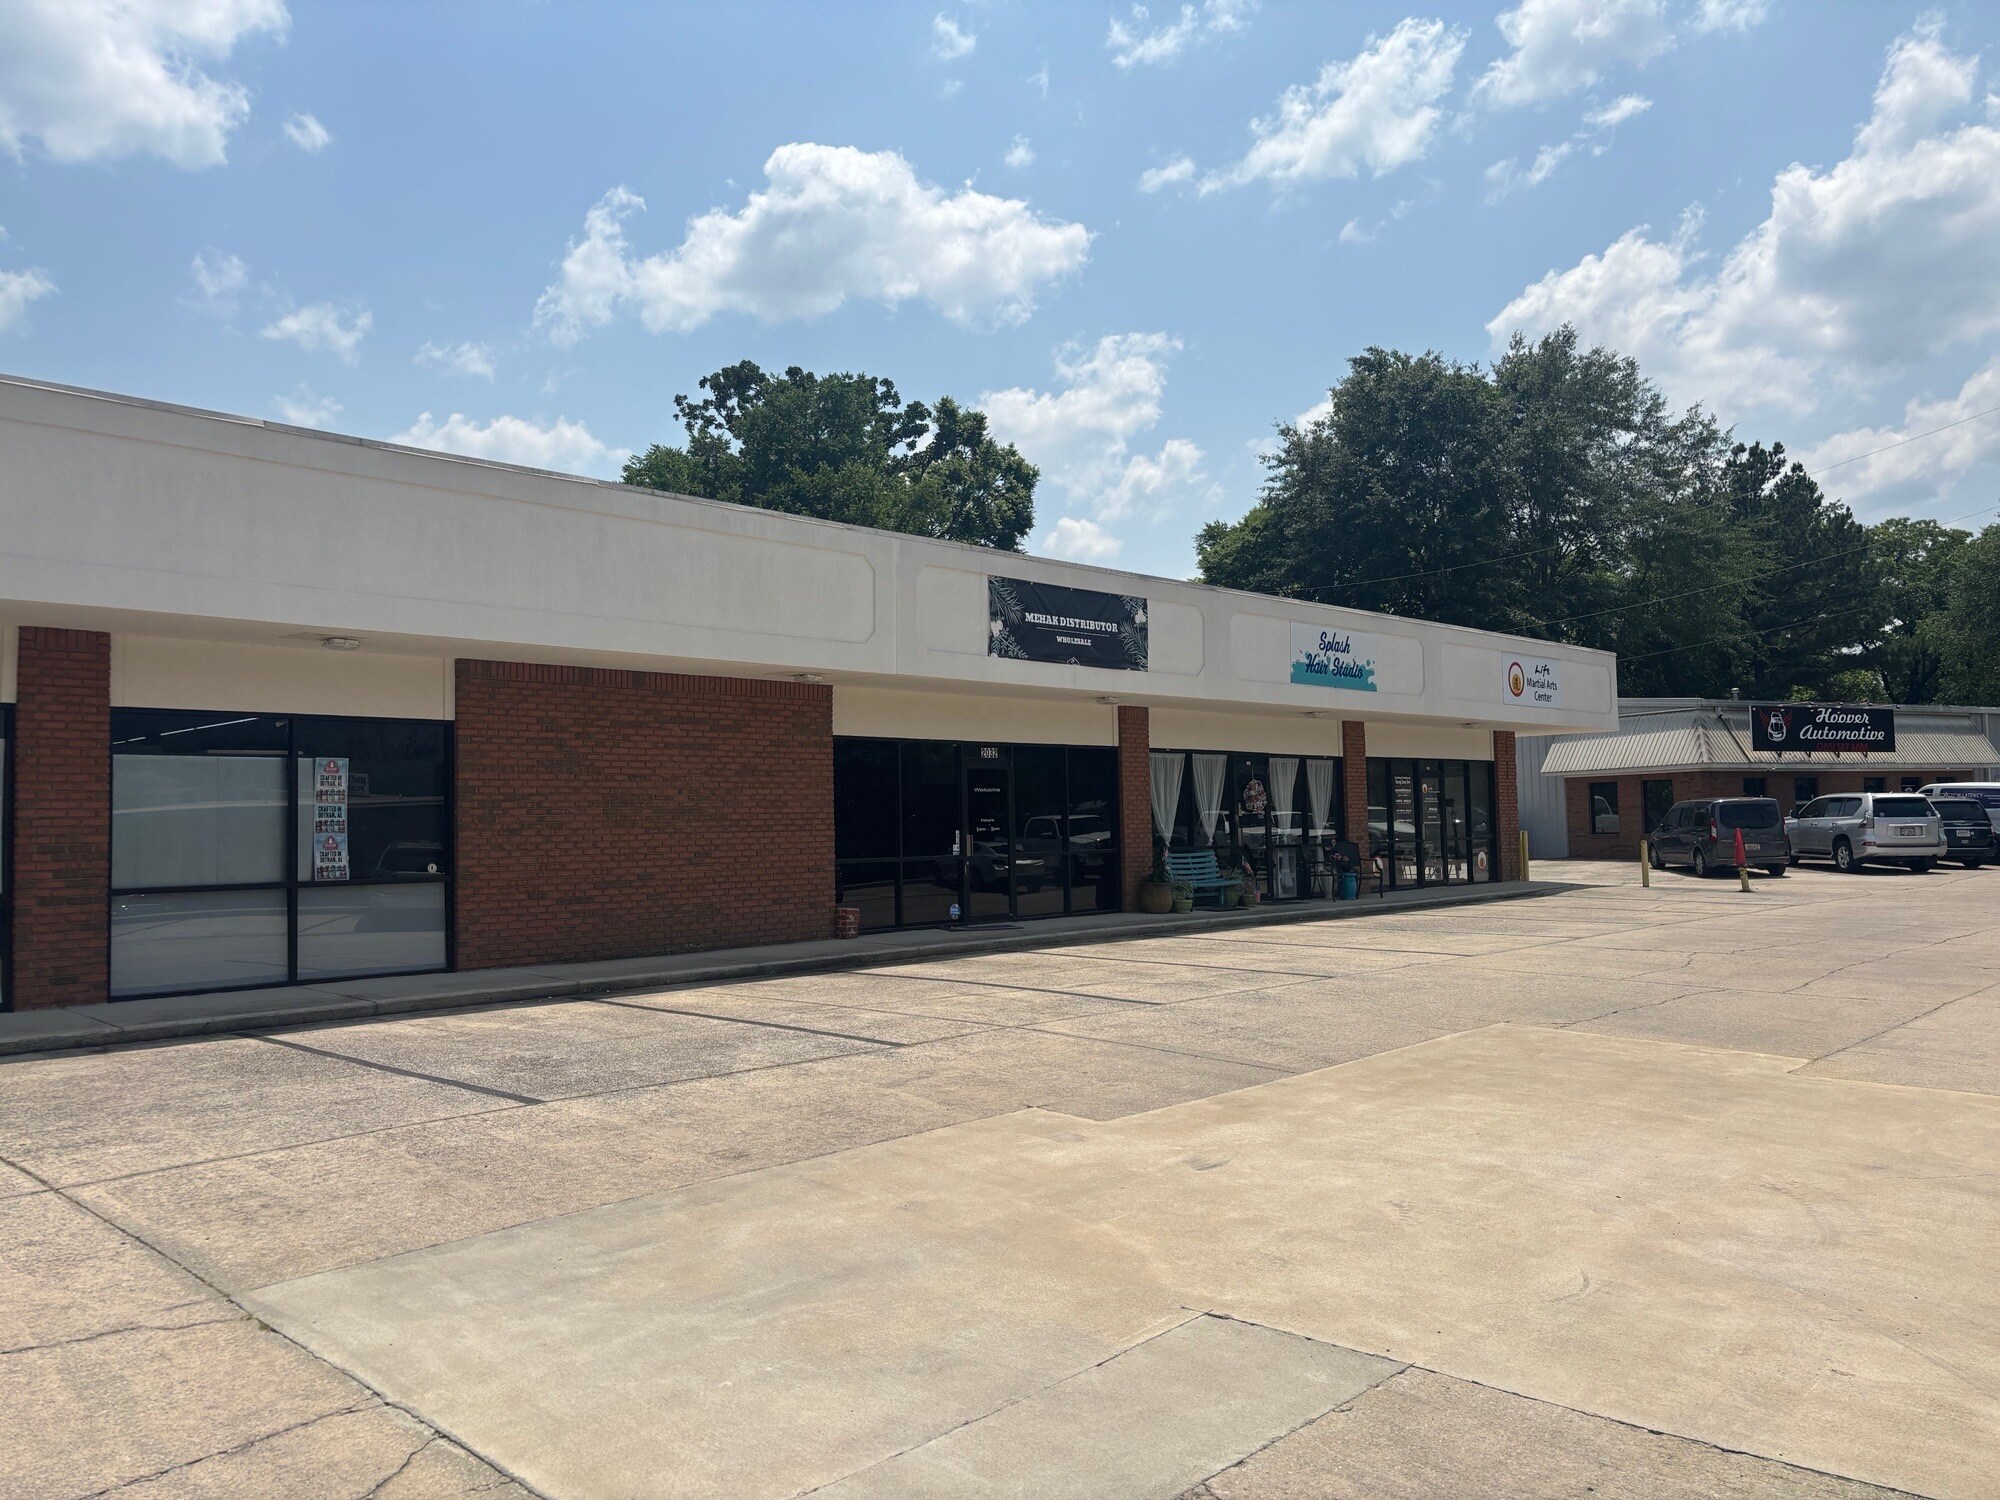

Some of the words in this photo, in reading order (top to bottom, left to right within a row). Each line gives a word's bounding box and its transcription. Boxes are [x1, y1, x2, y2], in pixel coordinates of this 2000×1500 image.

[1025, 612, 1059, 626] MEHAK
[1059, 616, 1118, 633] DISTRIBUTOR
[1056, 636, 1091, 646] WHOLESALE
[1319, 631, 1351, 657] Splash
[1305, 653, 1328, 676] Hair
[1332, 657, 1363, 679] Studio
[1535, 664, 1550, 677] Life
[1527, 677, 1545, 689] Martial
[1546, 680, 1558, 690] Arts
[1534, 691, 1552, 702] Center
[1815, 708, 1869, 724] Hoover
[1799, 724, 1885, 741] Automotive
[981, 748, 998, 758] 2032
